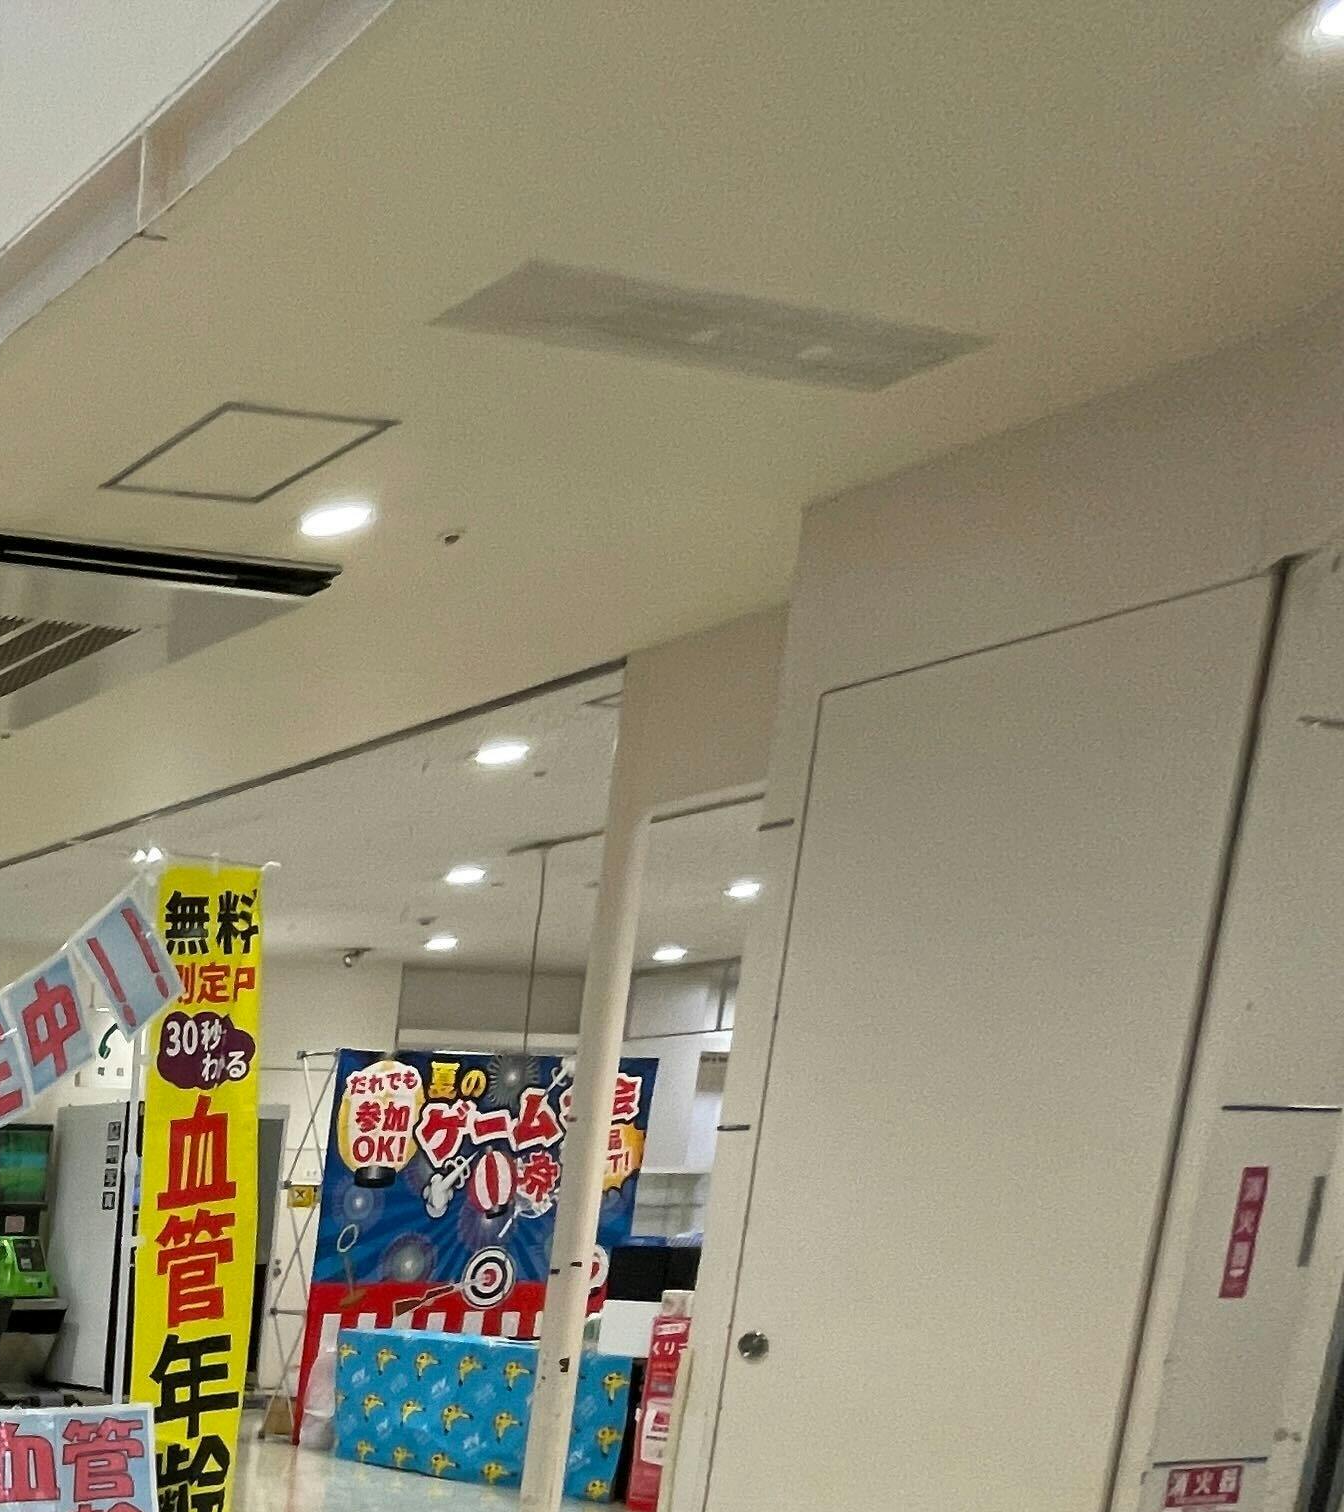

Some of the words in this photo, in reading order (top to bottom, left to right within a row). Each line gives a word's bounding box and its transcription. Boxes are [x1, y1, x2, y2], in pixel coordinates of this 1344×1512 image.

[165, 889, 259, 955] 無料
[350, 1071, 417, 1095] だれでも
[429, 1061, 487, 1099] 夏の
[355, 1101, 411, 1133] 参加
[352, 1135, 406, 1163] OK!
